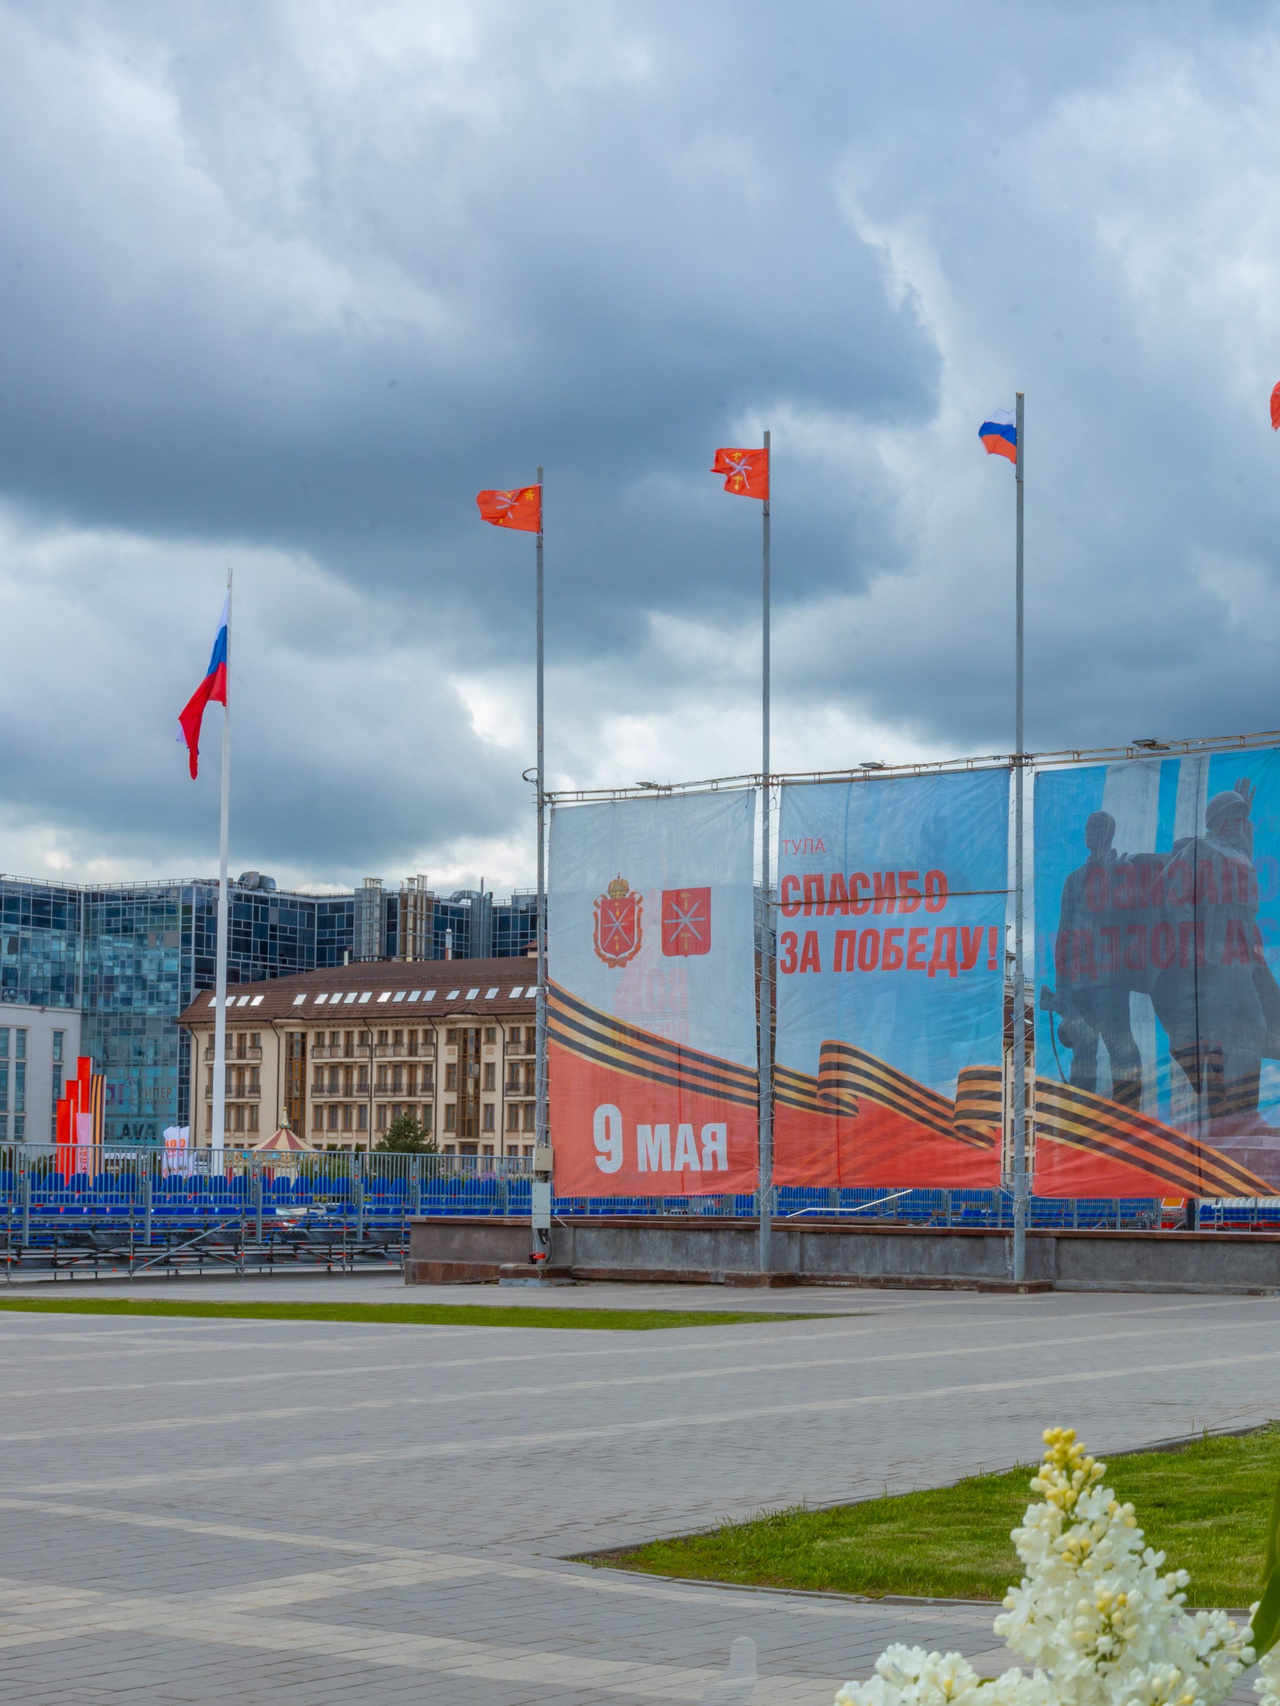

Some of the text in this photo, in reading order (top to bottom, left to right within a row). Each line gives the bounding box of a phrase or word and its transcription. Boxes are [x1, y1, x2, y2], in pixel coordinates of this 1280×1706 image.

[782, 838, 826, 855] ТУЛА
[780, 869, 948, 918] СПАСИБО
[779, 926, 998, 978] ЗА ПОБЕДУ!
[593, 1103, 729, 1174] 9 МАЯ
